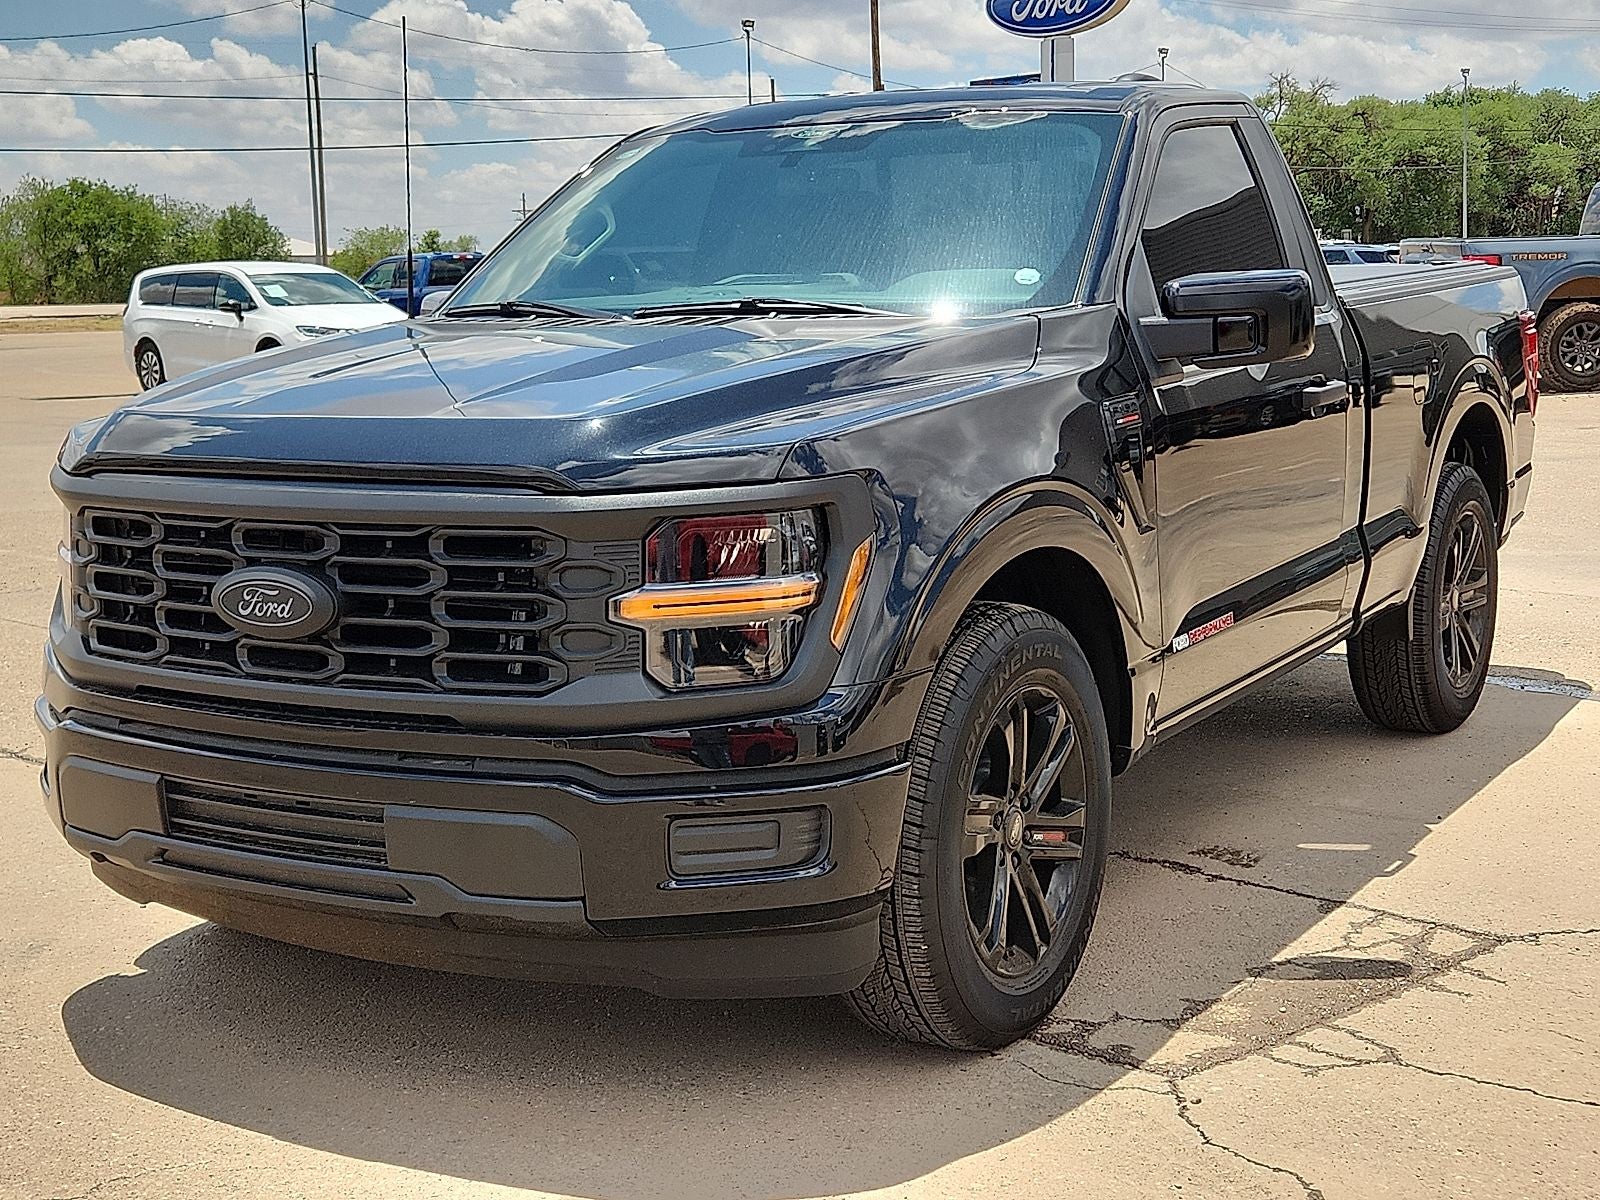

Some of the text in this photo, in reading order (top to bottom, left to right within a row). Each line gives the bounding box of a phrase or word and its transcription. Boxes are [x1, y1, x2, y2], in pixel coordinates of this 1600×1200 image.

[1010, 0, 1089, 22] Ford
[1510, 252, 1569, 261] TREMOR
[238, 586, 294, 619] Ford
